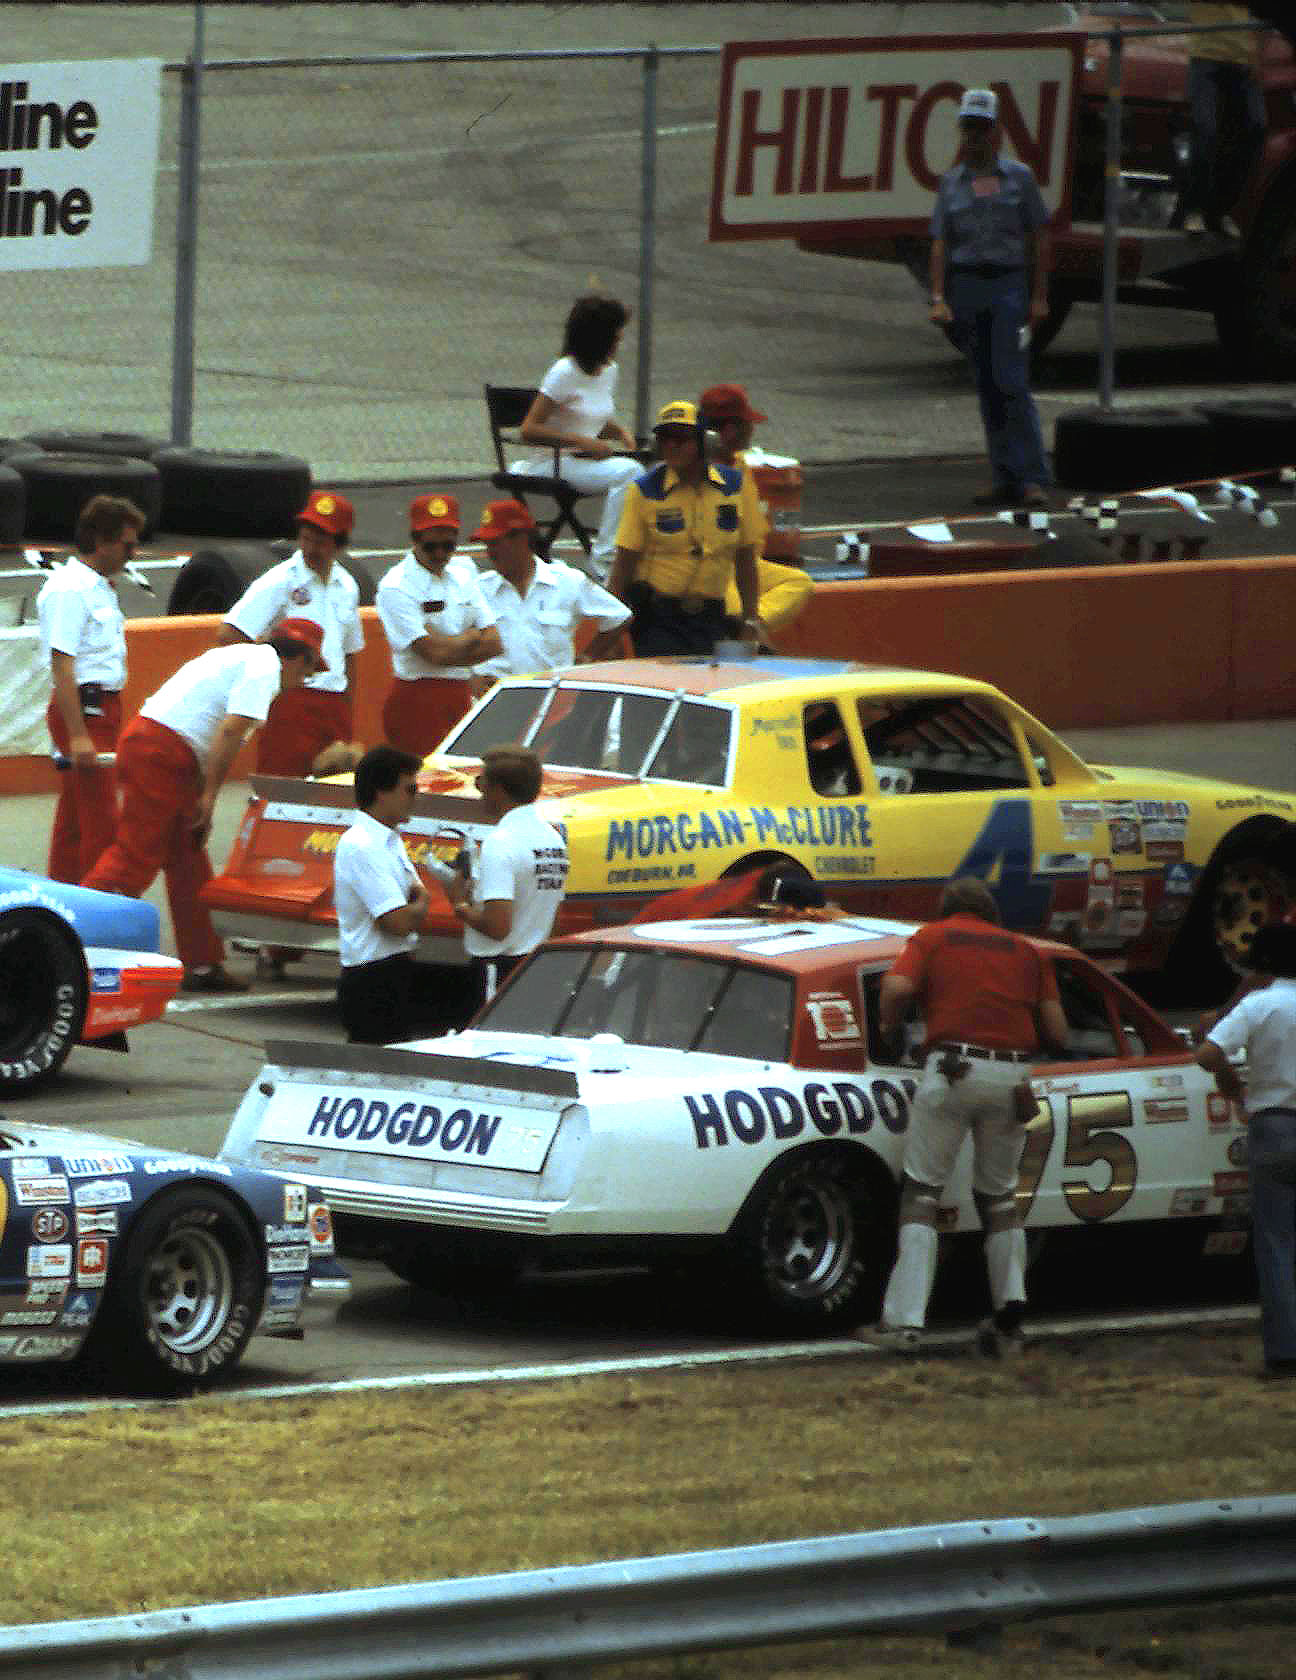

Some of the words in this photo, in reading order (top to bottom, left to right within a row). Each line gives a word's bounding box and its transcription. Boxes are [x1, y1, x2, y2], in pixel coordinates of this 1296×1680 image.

[734, 79, 1060, 197] HILTON
[950, 798, 1053, 928] 4
[307, 1096, 503, 1156] HODGDON
